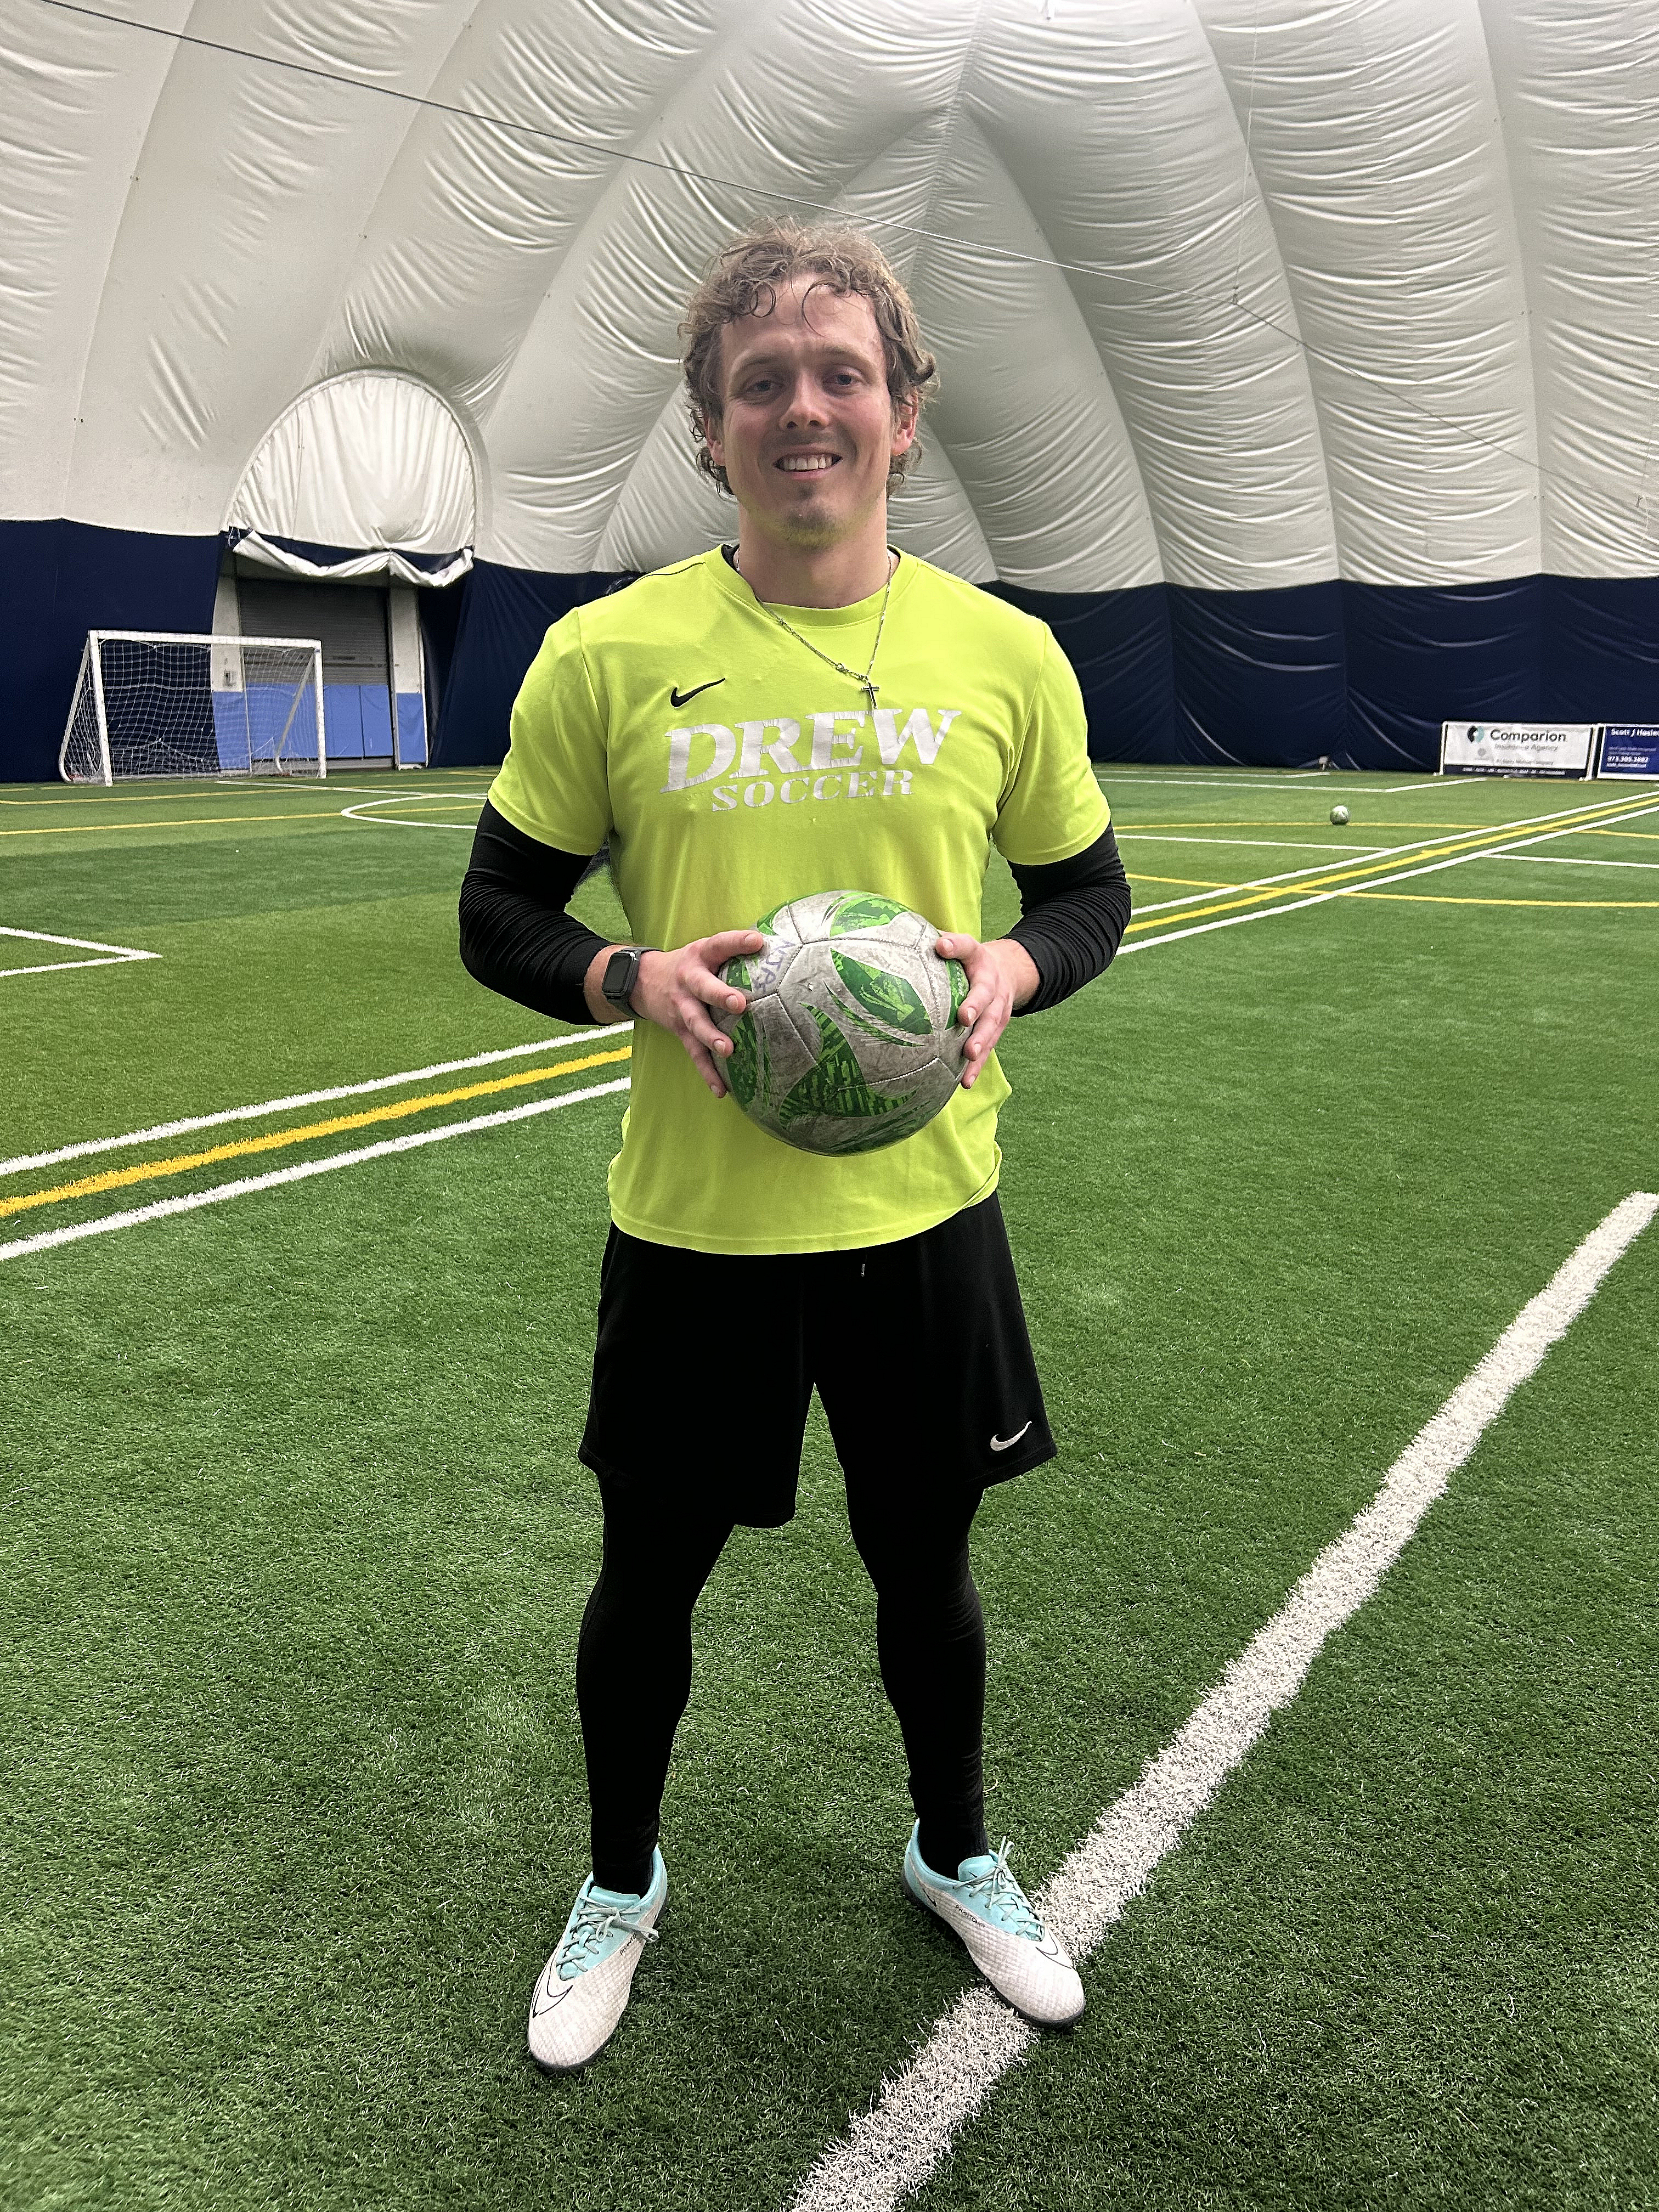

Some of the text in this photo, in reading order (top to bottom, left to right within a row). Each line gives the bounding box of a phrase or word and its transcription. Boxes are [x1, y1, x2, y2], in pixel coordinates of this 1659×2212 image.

[660, 708, 962, 793] DREW
[1491, 729, 1566, 743] Comparion
[712, 770, 913, 811] SOCCER
[619, 1933, 636, 1956] PHANTO
